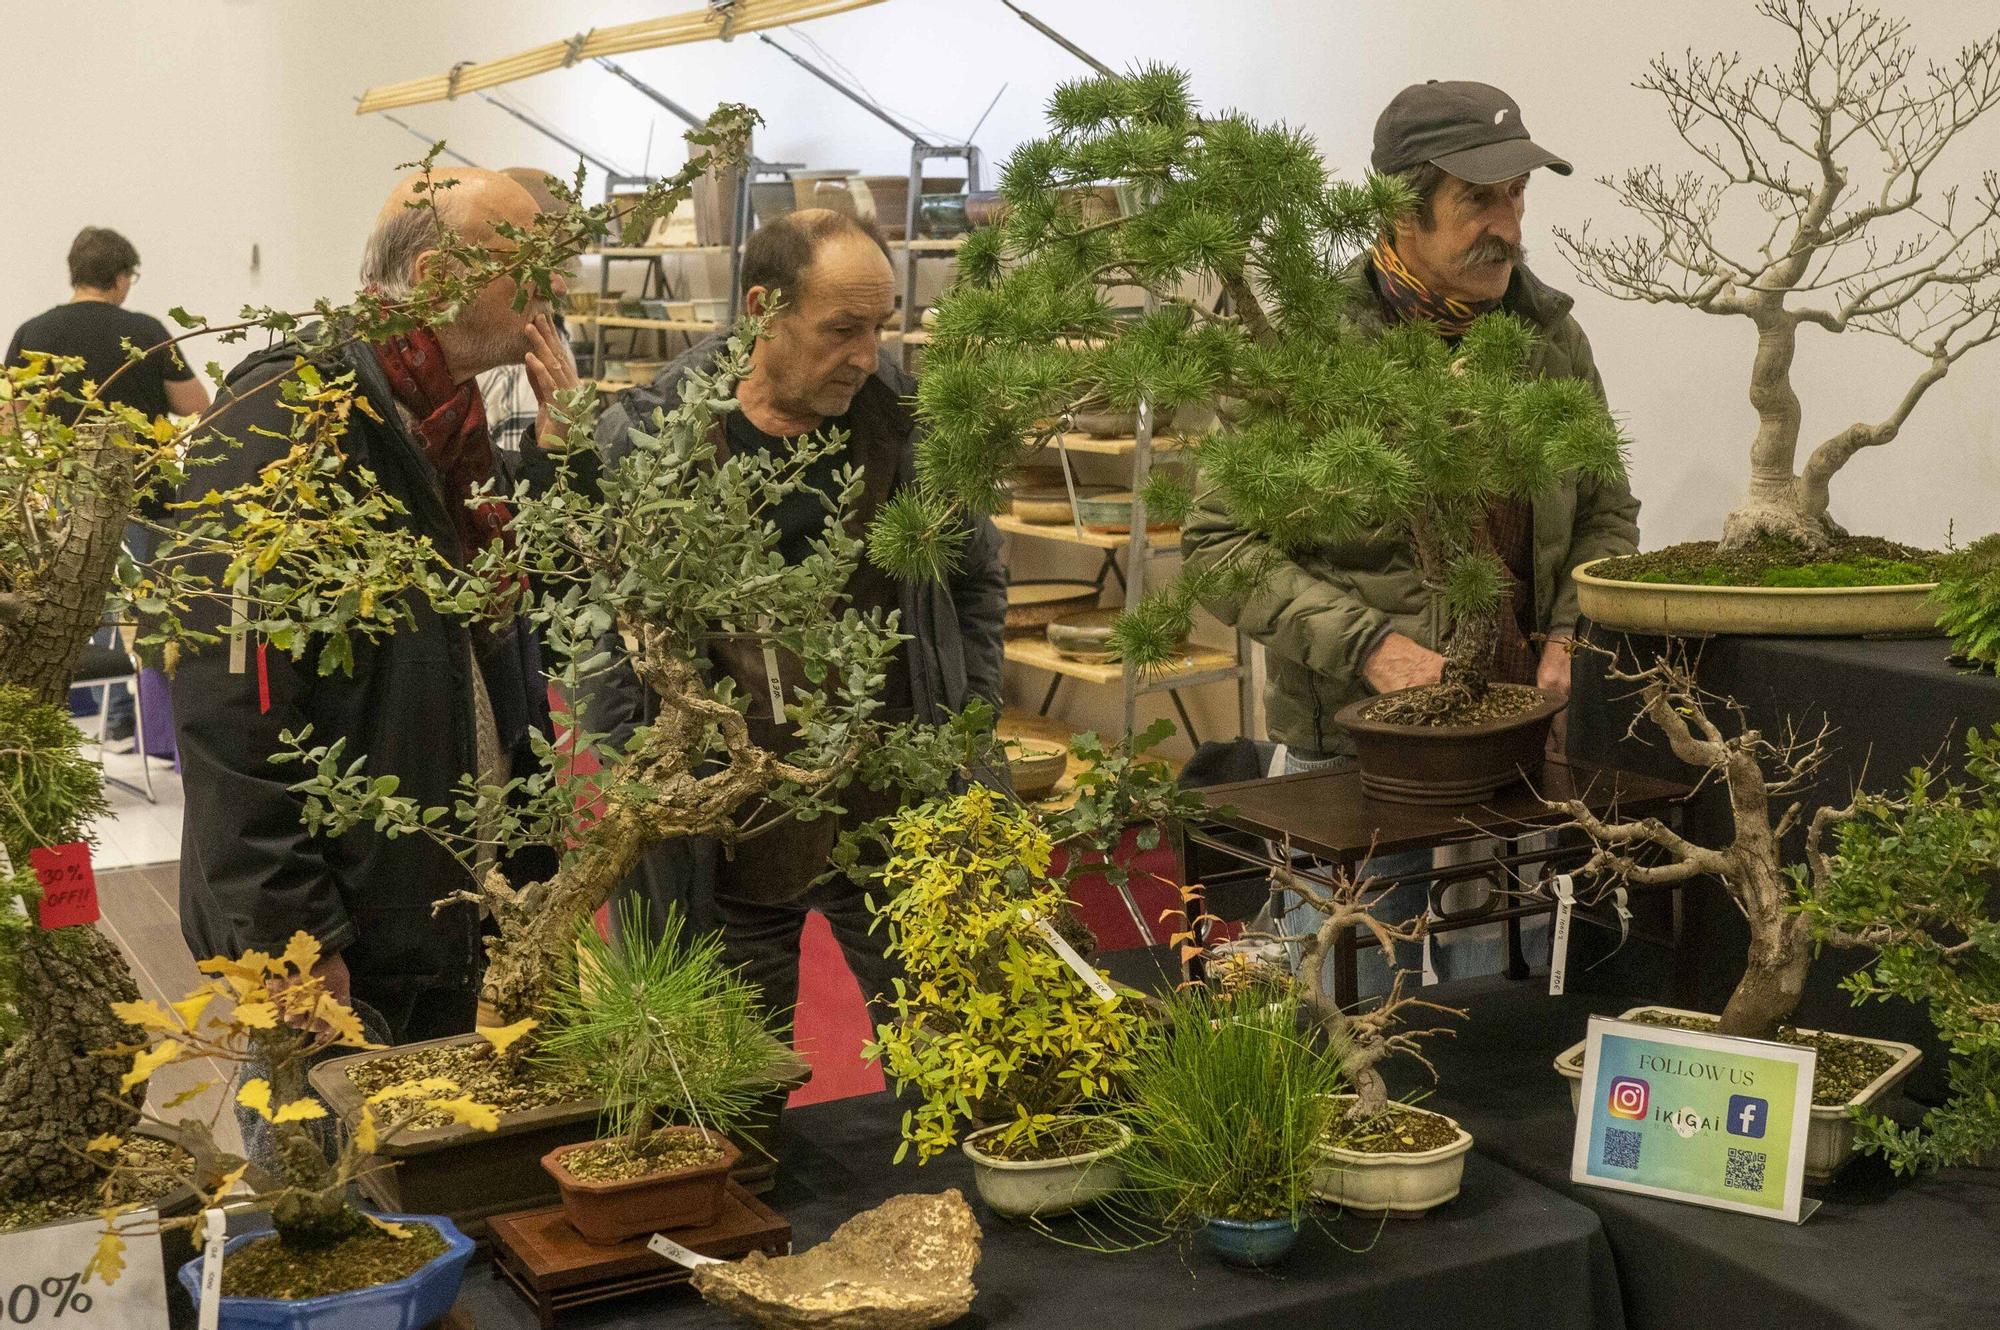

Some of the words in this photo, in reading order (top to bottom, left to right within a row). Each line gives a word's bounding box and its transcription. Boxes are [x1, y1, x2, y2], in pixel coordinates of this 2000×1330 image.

[1639, 1054, 1726, 1081] FOLLOW
[1729, 1068, 1755, 1087] US
[0, 1272, 93, 1324] 0%
